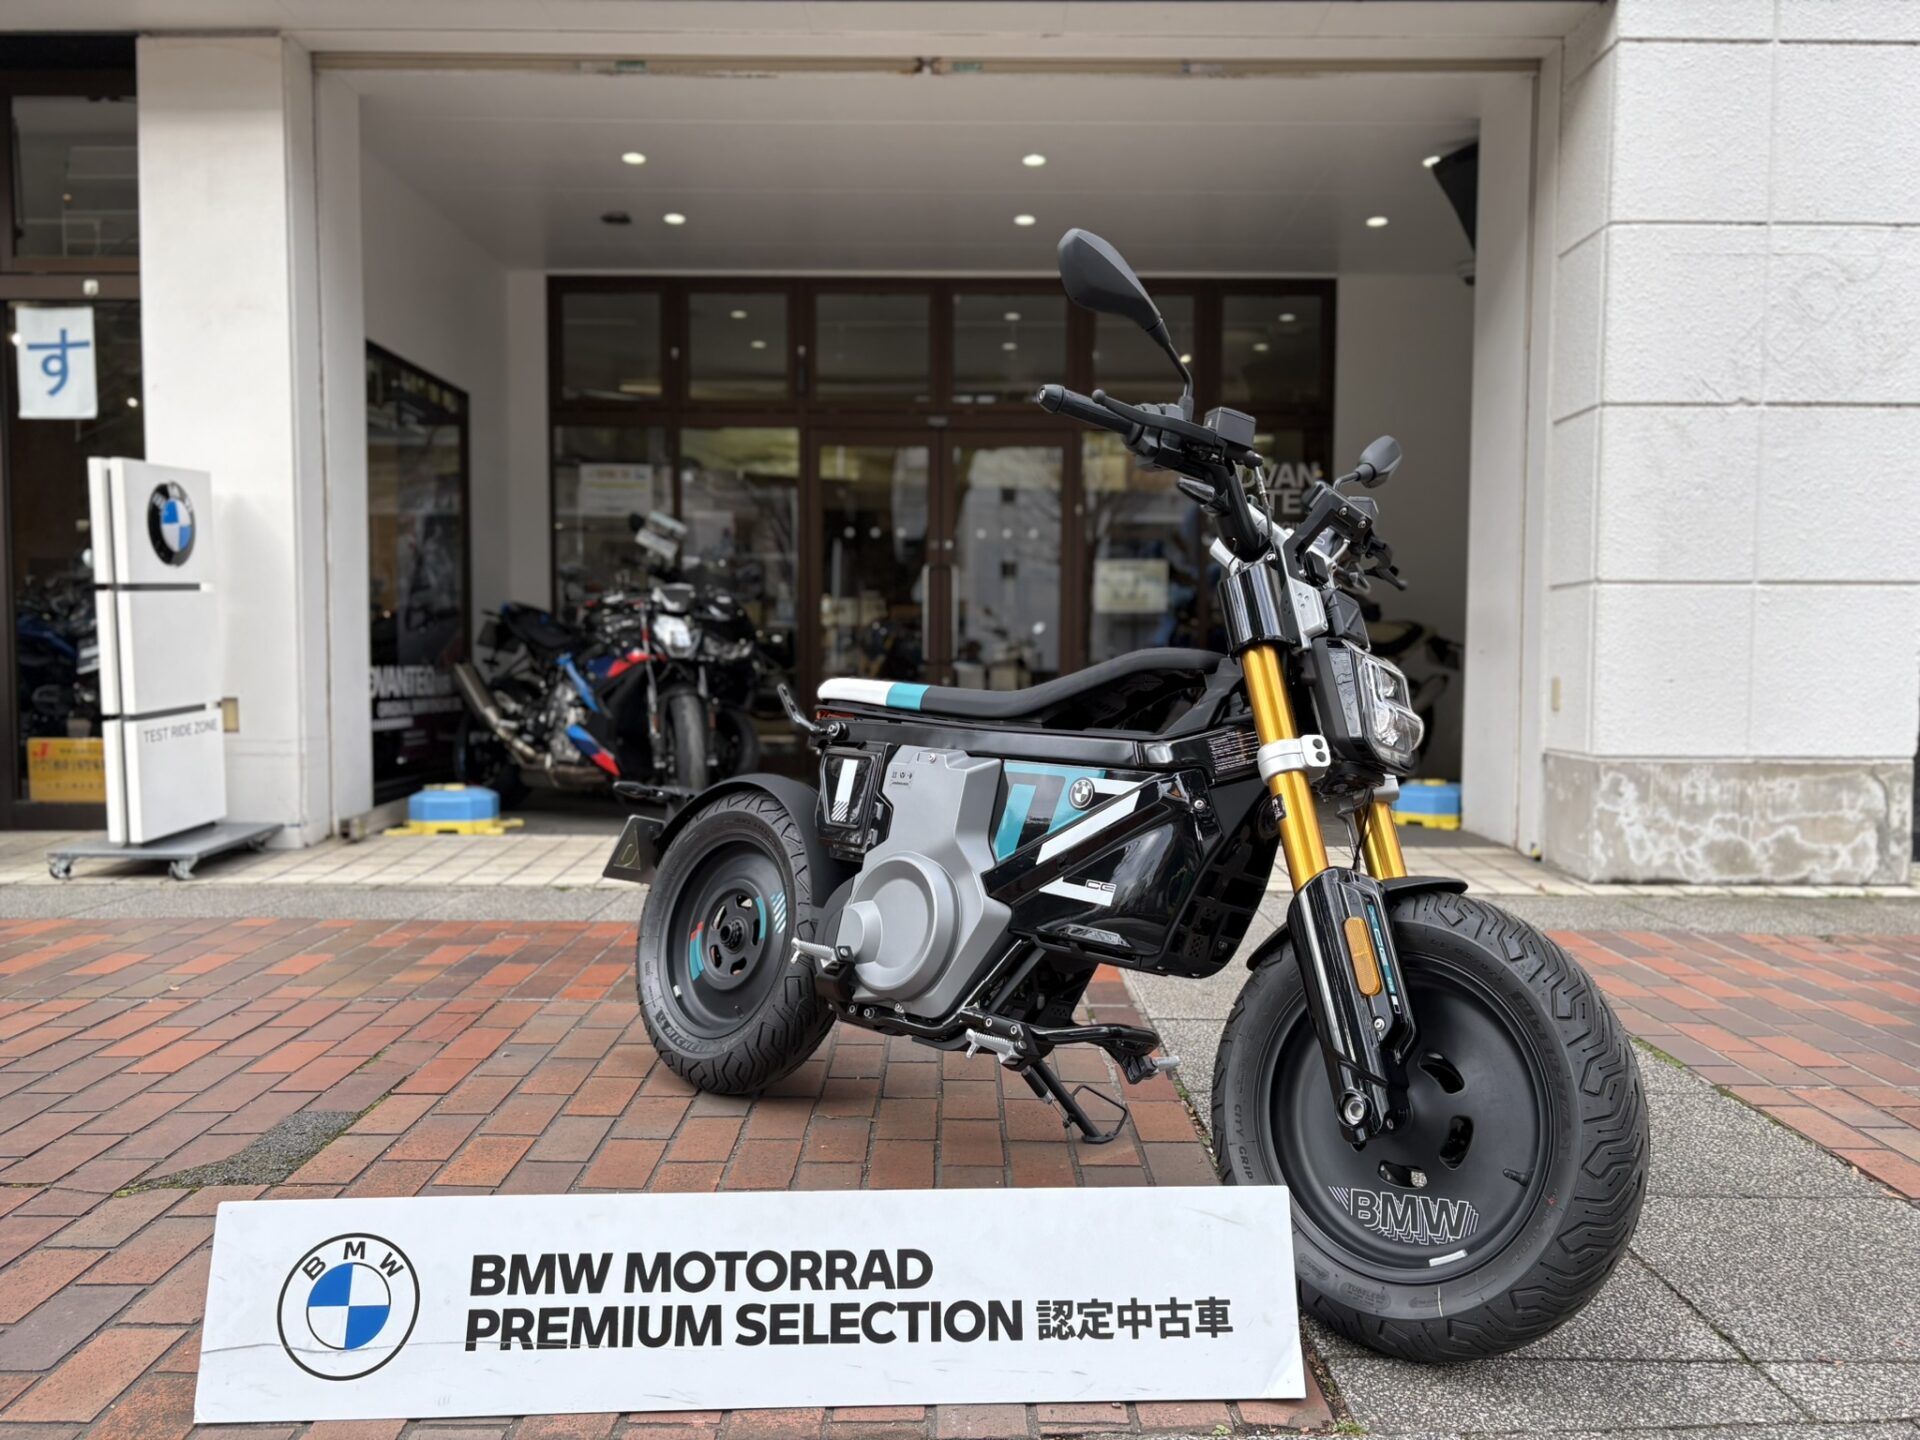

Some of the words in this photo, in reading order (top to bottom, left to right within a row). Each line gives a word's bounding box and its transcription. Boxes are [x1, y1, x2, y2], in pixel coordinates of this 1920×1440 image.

[27, 329, 90, 395] す
[144, 726, 169, 743] TEST
[171, 722, 193, 738] RIDE
[195, 717, 217, 735] ZONE
[1086, 880, 1116, 893] CE
[664, 1026, 714, 1054] MICHELI
[1234, 1103, 1244, 1137] CITY
[1239, 1146, 1254, 1179] GRIP
[1349, 1187, 1473, 1242] BMW
[303, 1242, 403, 1281] BMW
[471, 1253, 613, 1296] BMW
[624, 1249, 933, 1293] MOTORRAD
[465, 1305, 721, 1351] PREMIUM
[736, 1301, 1022, 1346] SELECTION
[1039, 1297, 1233, 1340] 認定中古車
